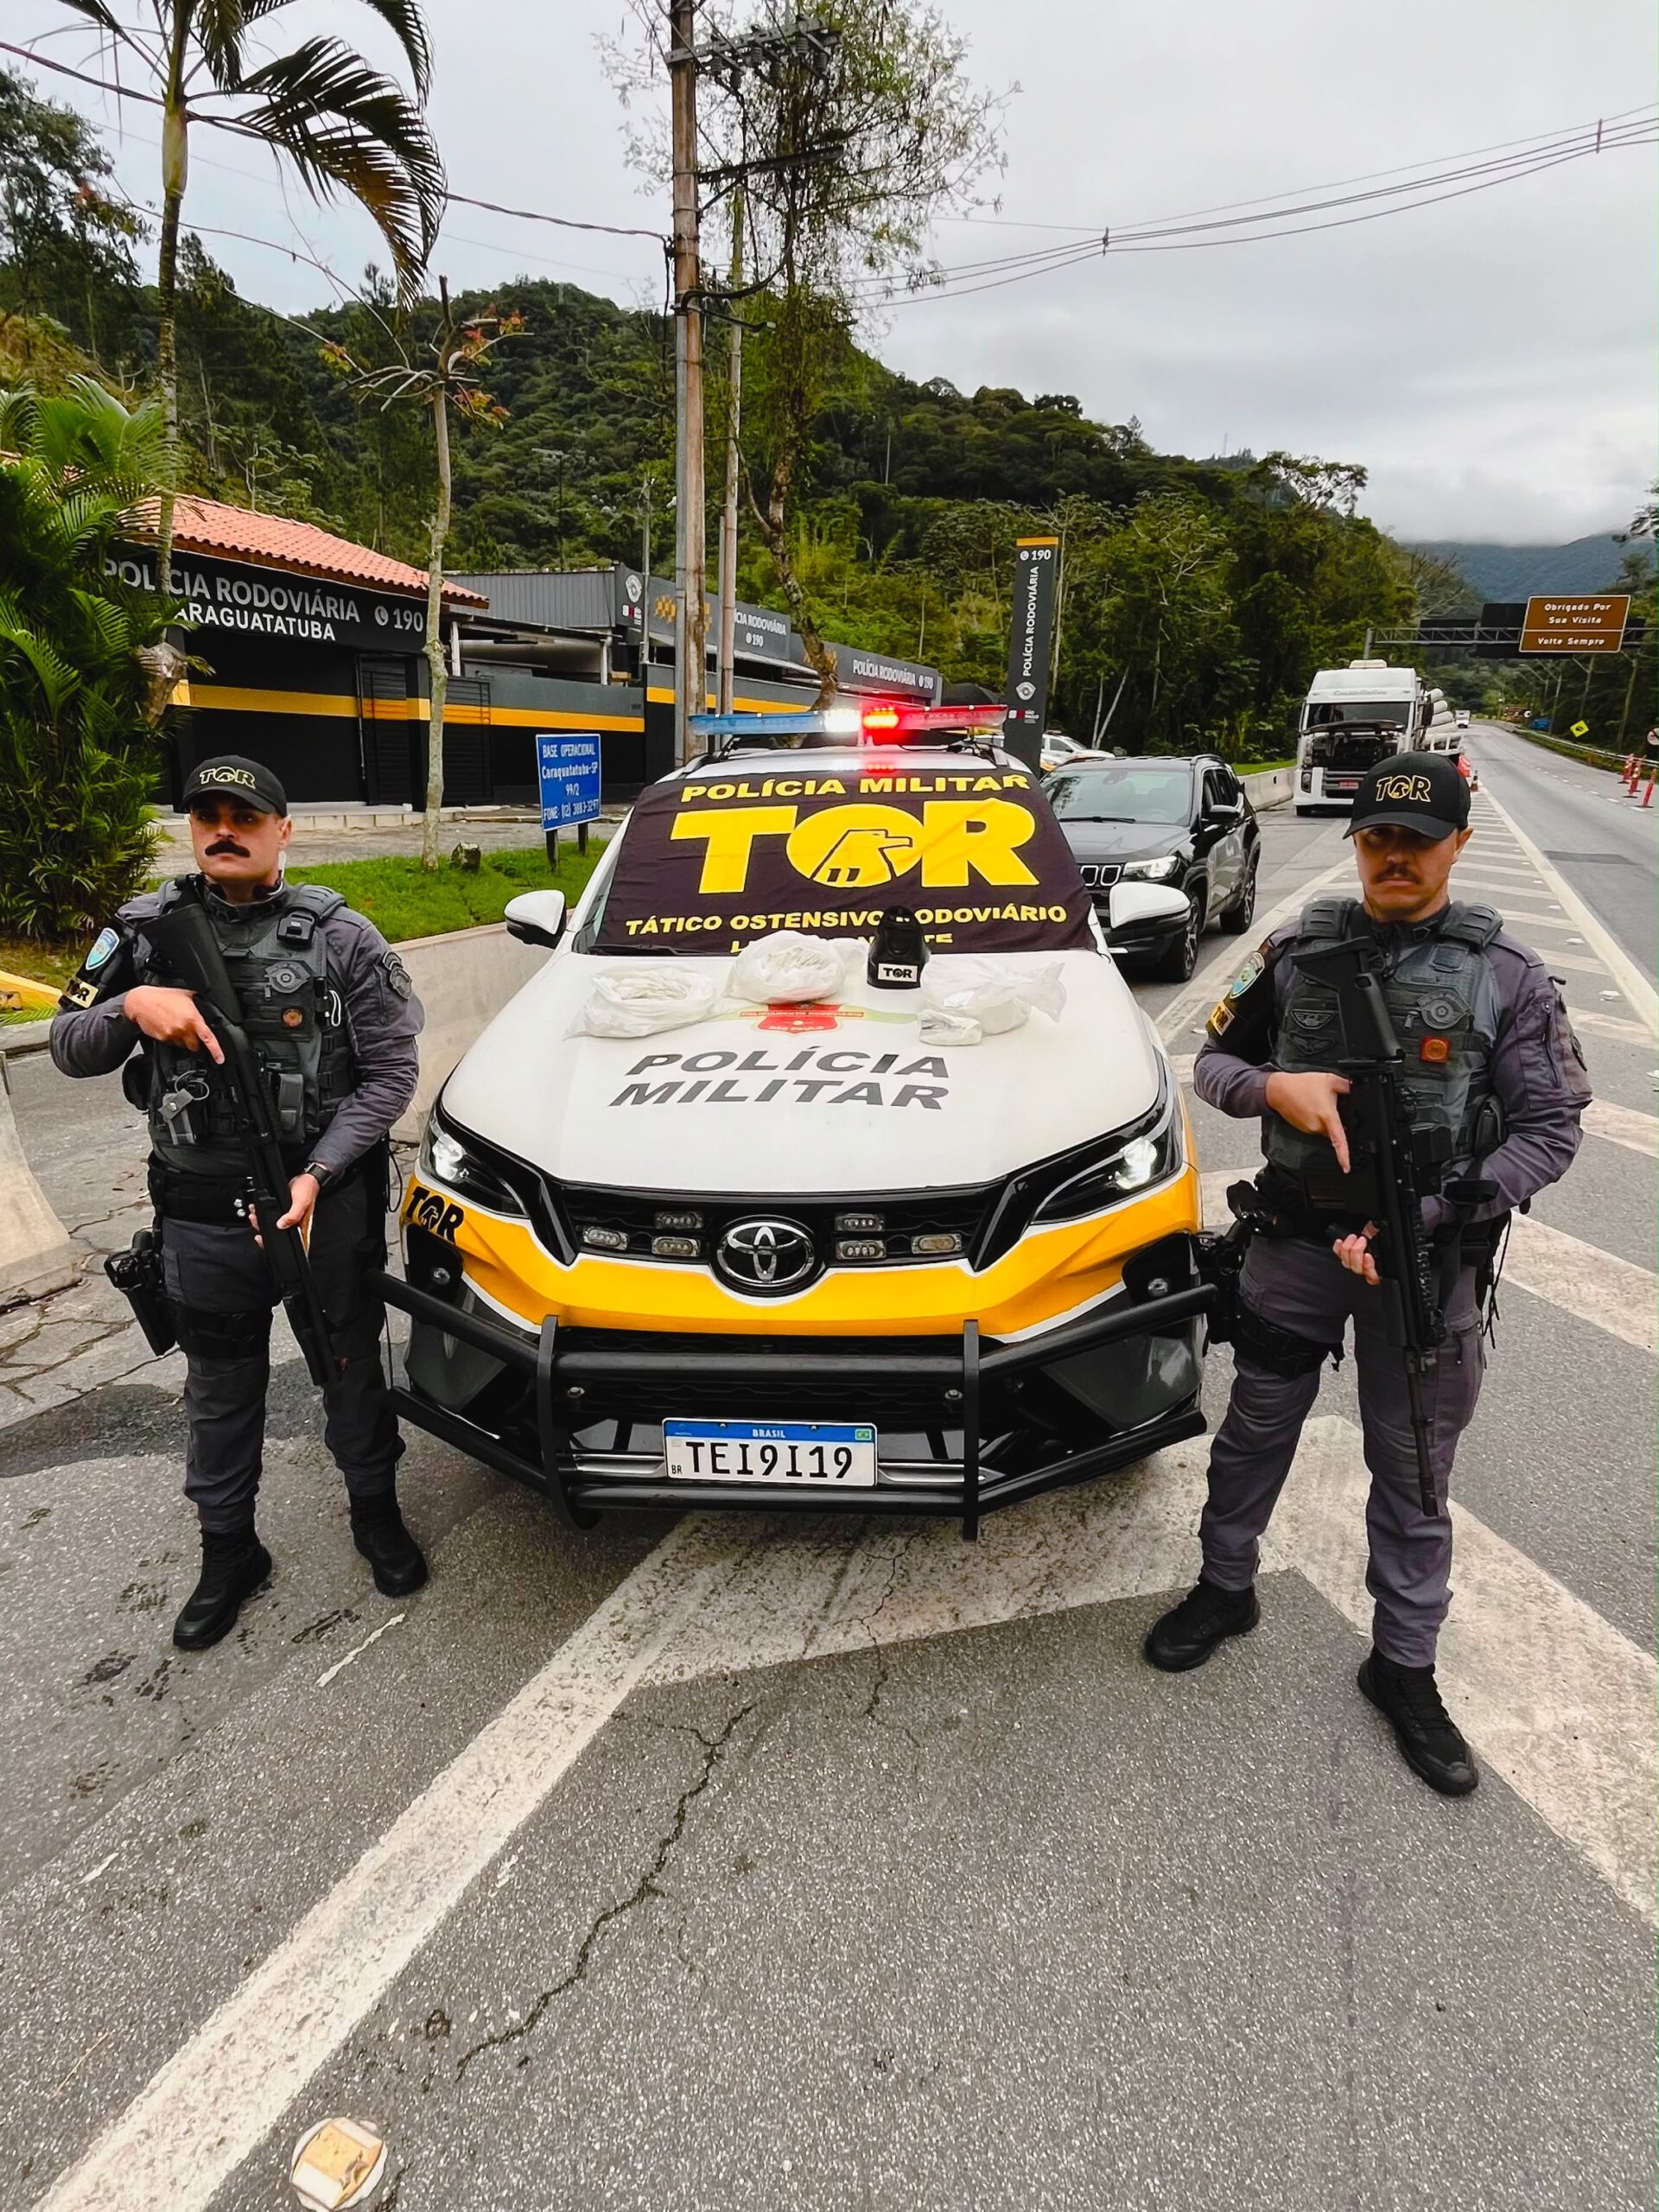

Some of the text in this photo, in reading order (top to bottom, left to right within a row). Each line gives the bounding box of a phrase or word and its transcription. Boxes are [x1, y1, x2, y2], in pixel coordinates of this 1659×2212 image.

[1032, 550, 1052, 561] 190
[104, 557, 423, 632] POLCIA RODOVIÁRIA 190
[1544, 603, 1590, 613] Obrigado
[174, 602, 336, 641] ARAGUATATUBA
[1022, 566, 1039, 677] POLÍCIA RODOVIÁRIA
[853, 659, 879, 678] POLÍCIA
[542, 744, 558, 759] BASE
[199, 766, 257, 790] TOR
[565, 783, 580, 796] 99/2
[680, 773, 1031, 803] POLÍCIA MILITAR
[1376, 774, 1432, 802] TOR
[670, 797, 1041, 894] TOR
[626, 903, 1068, 937] TÁTICO OSTENSIVO ODOVIÁRIO
[882, 967, 913, 979] TOR
[625, 1045, 950, 1078] POLÍCIA
[607, 1078, 950, 1110] MILITAR
[405, 1185, 465, 1245] TOR
[752, 1428, 785, 1439] BRASIL
[671, 1441, 853, 1479] BR TEI9I19
